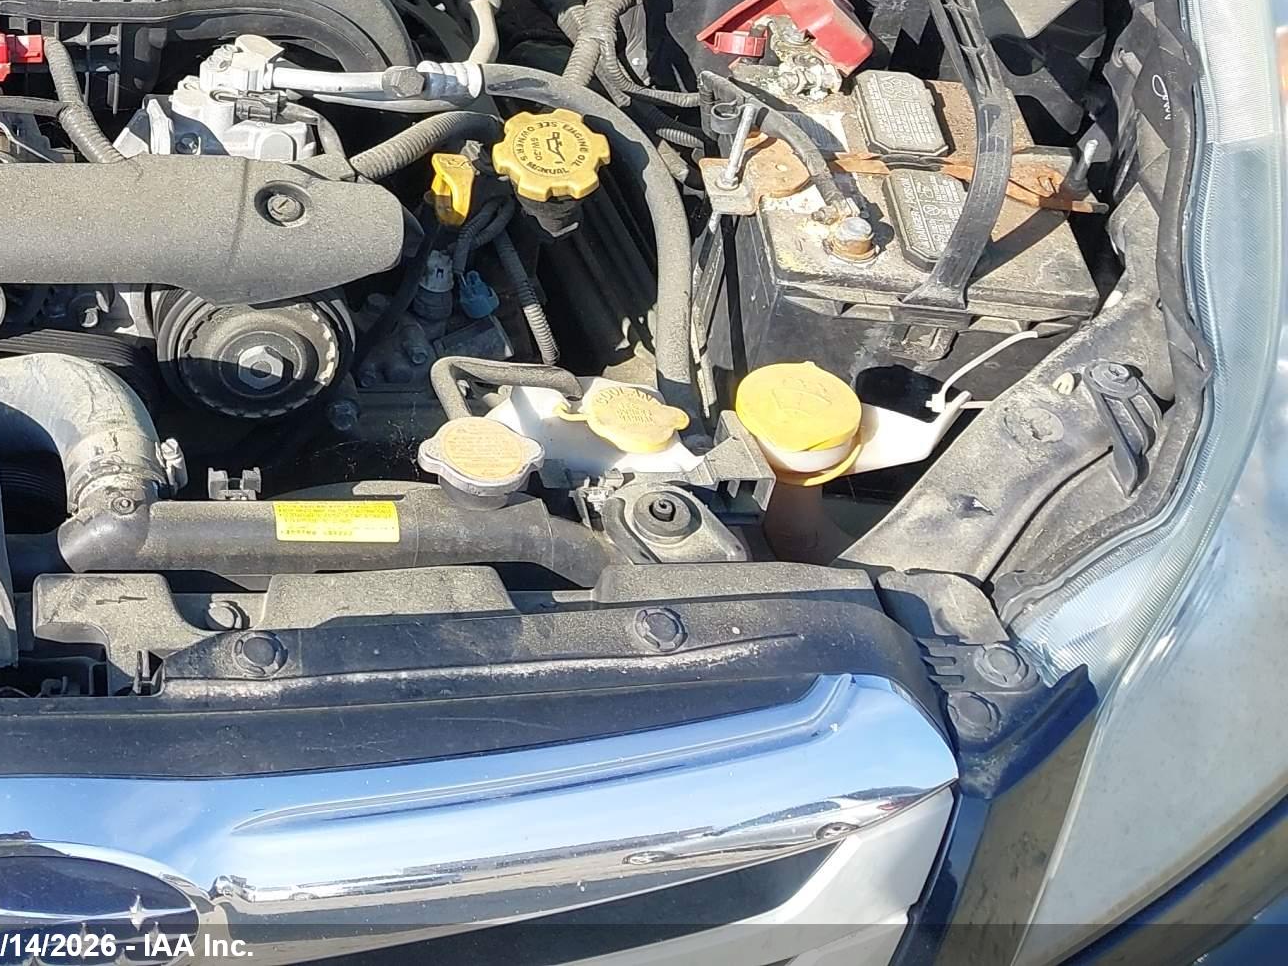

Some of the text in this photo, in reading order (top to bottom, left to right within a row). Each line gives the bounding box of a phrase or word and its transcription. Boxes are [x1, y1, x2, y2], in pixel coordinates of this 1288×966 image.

[536, 121, 558, 129] SEE
[562, 123, 589, 167] ENGINE OIL
[527, 161, 570, 175] MANUAL
